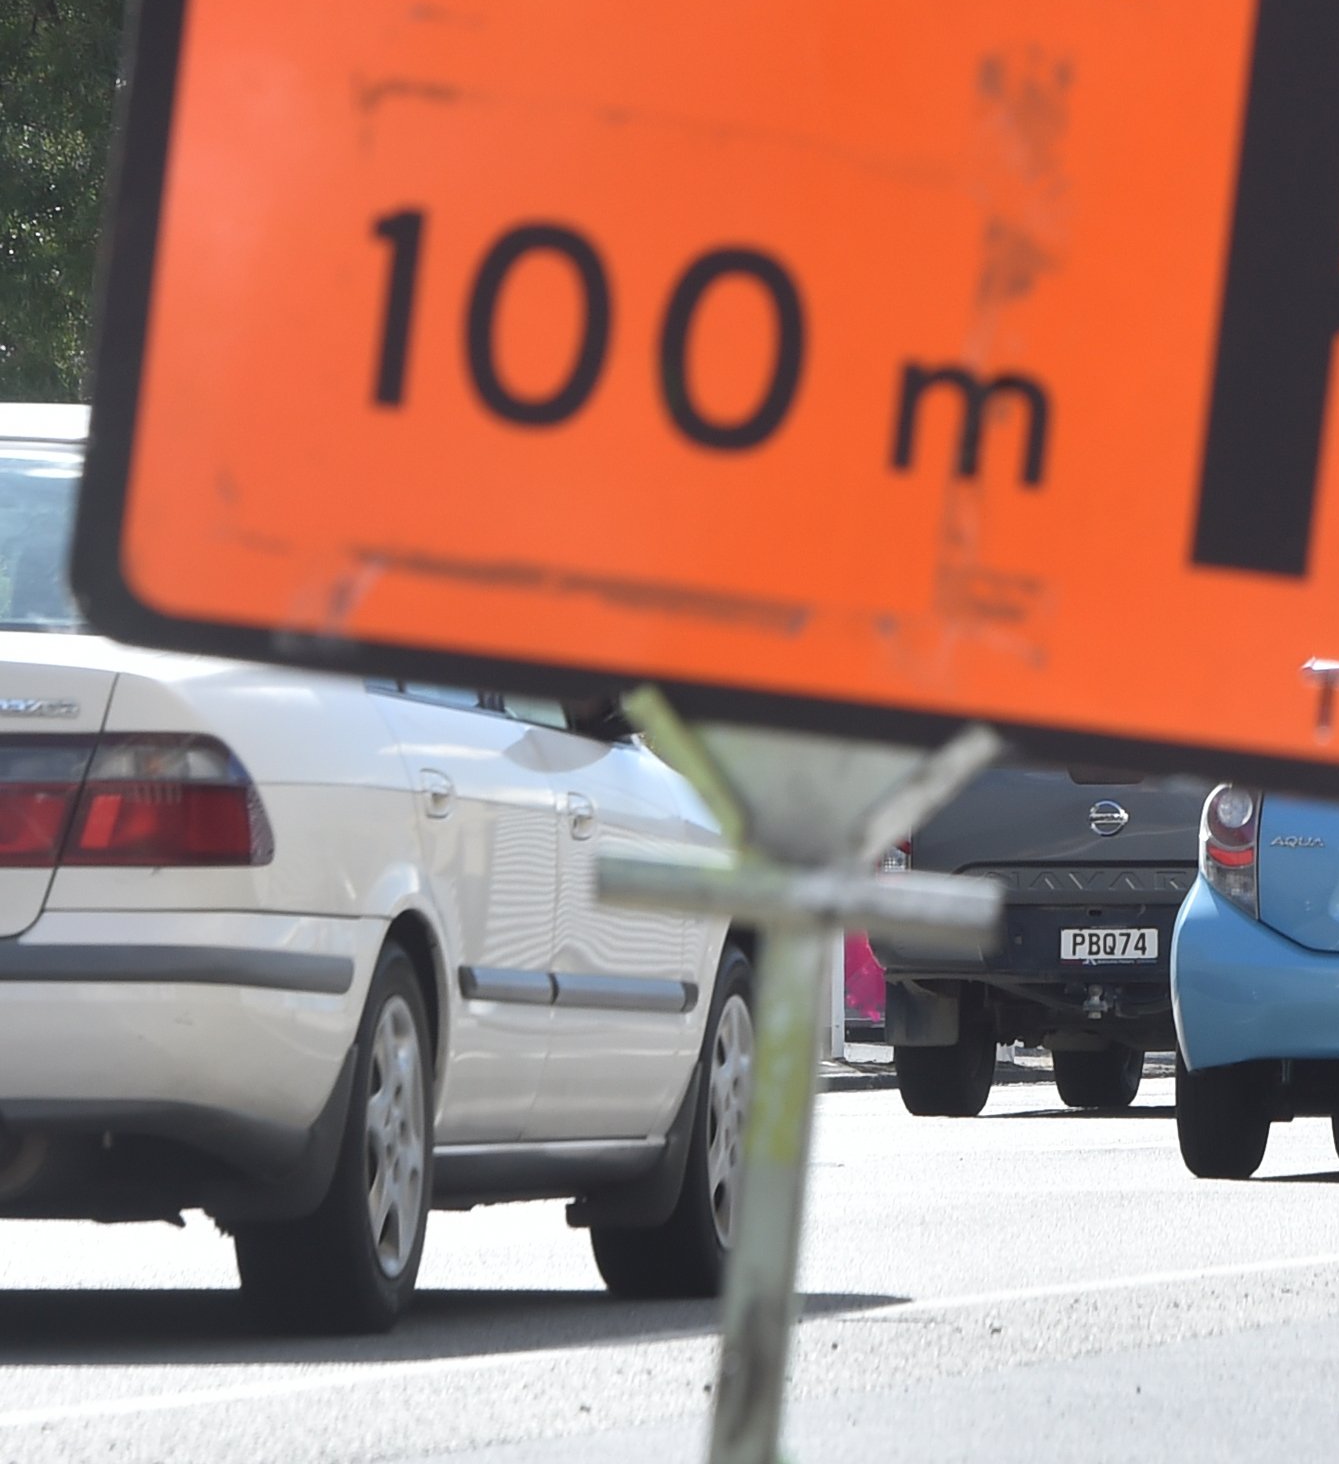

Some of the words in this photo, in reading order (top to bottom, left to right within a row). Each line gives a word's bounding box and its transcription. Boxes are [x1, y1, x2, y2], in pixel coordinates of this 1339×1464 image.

[368, 209, 808, 452] 100
[889, 357, 1053, 489] m
[1269, 835, 1326, 849] AQUA
[1071, 932, 1148, 957] PBQ74
